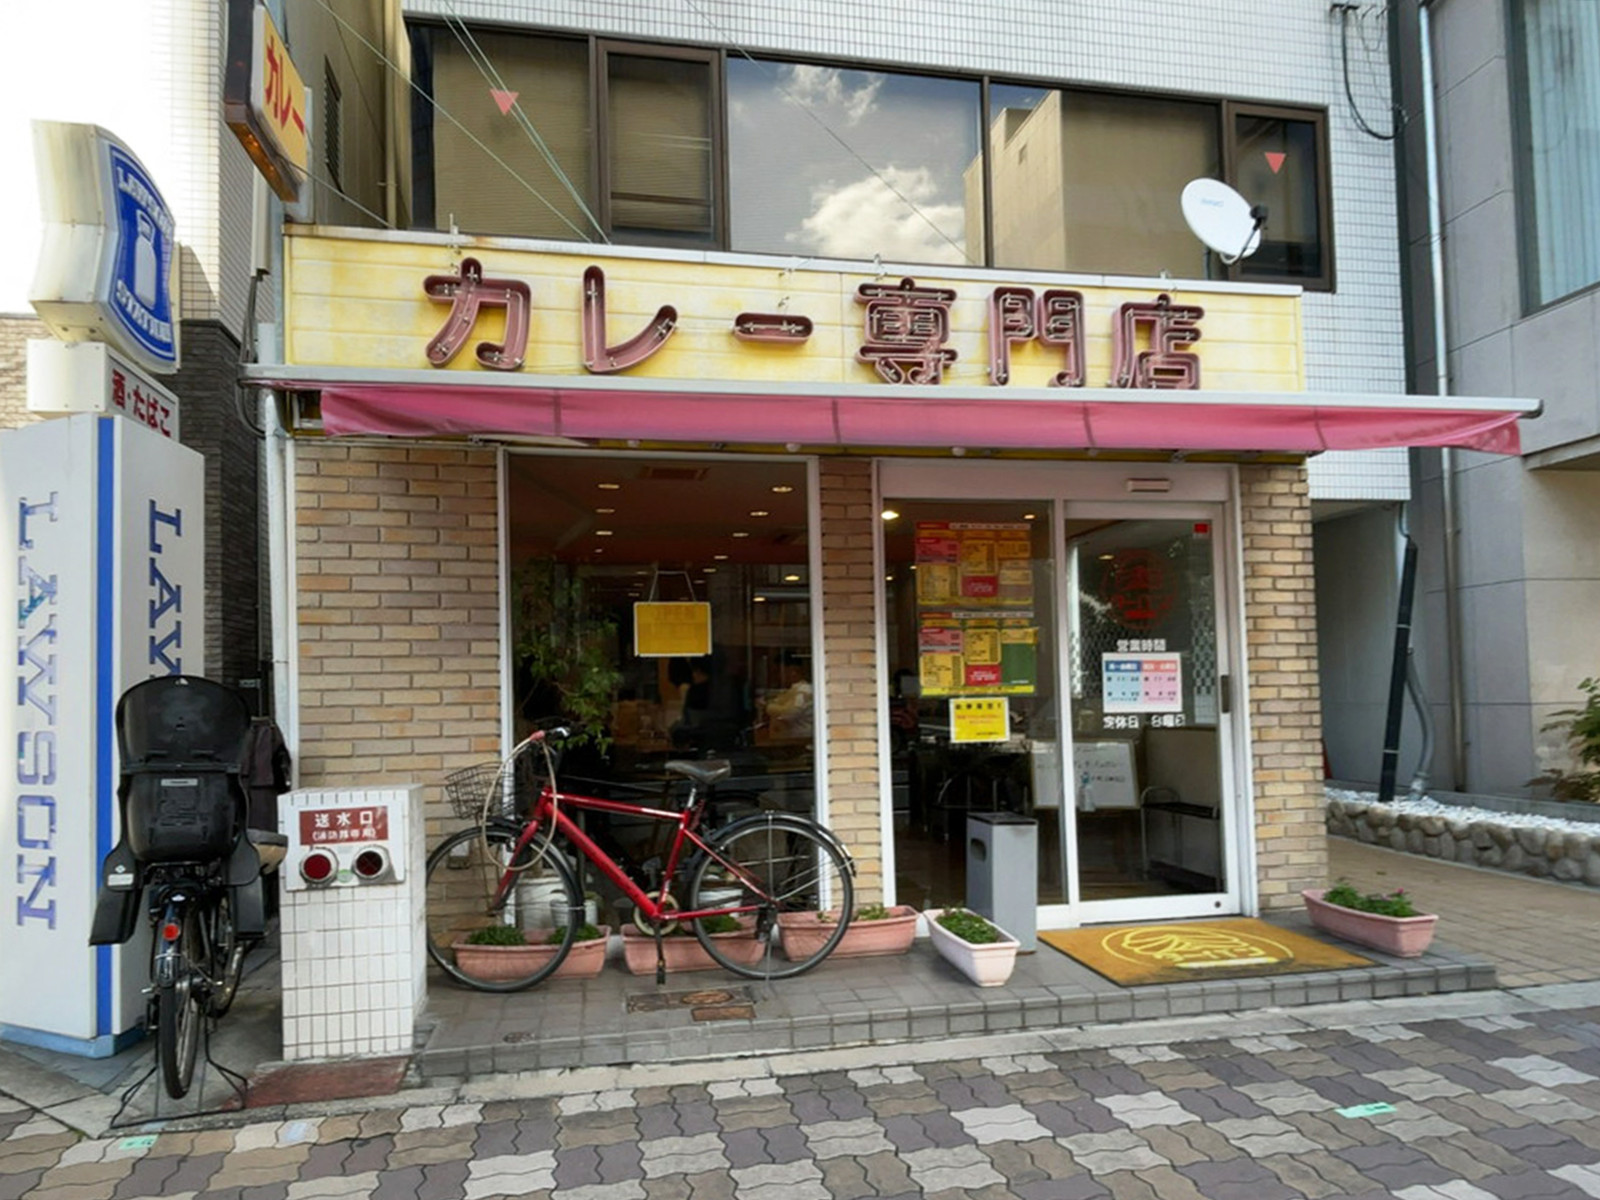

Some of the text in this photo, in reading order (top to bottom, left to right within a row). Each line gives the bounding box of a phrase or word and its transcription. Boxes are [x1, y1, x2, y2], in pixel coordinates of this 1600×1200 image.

[264, 34, 306, 136] カレー
[423, 257, 1205, 389] カレー専門店
[112, 368, 172, 438] 酒・たばこ
[17, 491, 58, 931] LAWSON
[314, 811, 374, 828] 送水口
